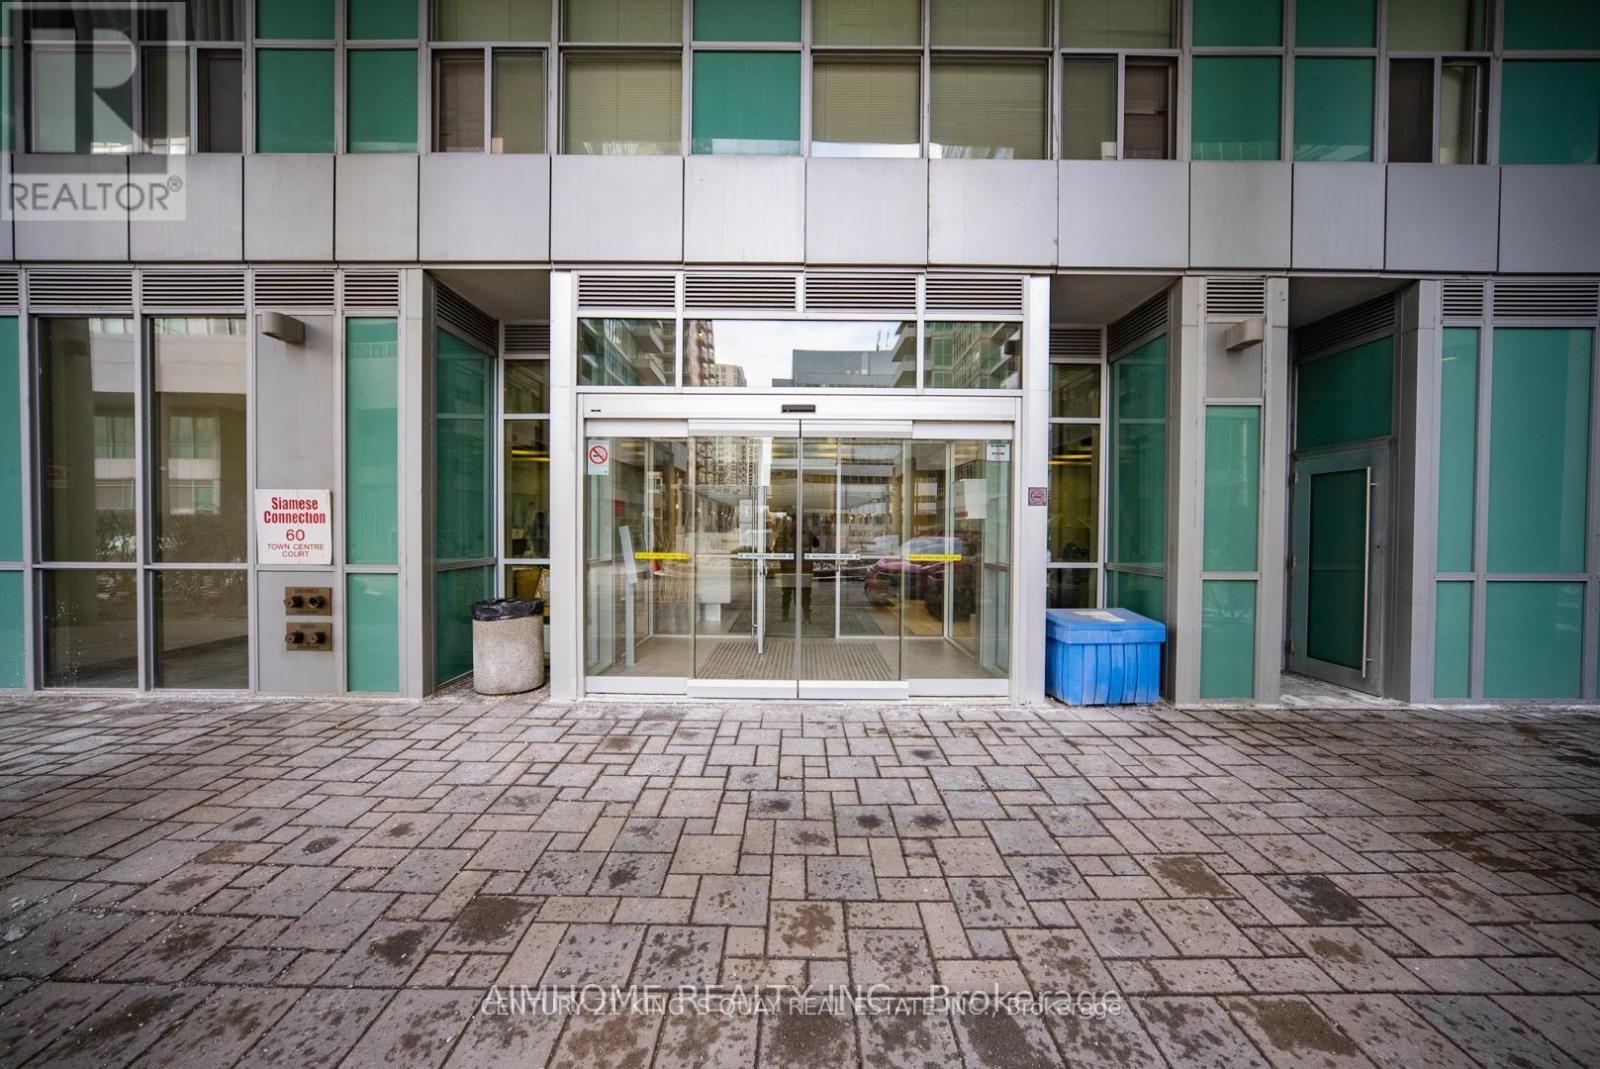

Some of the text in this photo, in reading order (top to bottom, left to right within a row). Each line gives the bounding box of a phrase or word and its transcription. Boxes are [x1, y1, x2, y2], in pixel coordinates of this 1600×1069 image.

[271, 497, 319, 510] Siamese
[264, 511, 326, 524] Connection
[286, 529, 306, 542] 60
[267, 543, 324, 551] TOWN CENTRE
[281, 550, 310, 558] COURT
